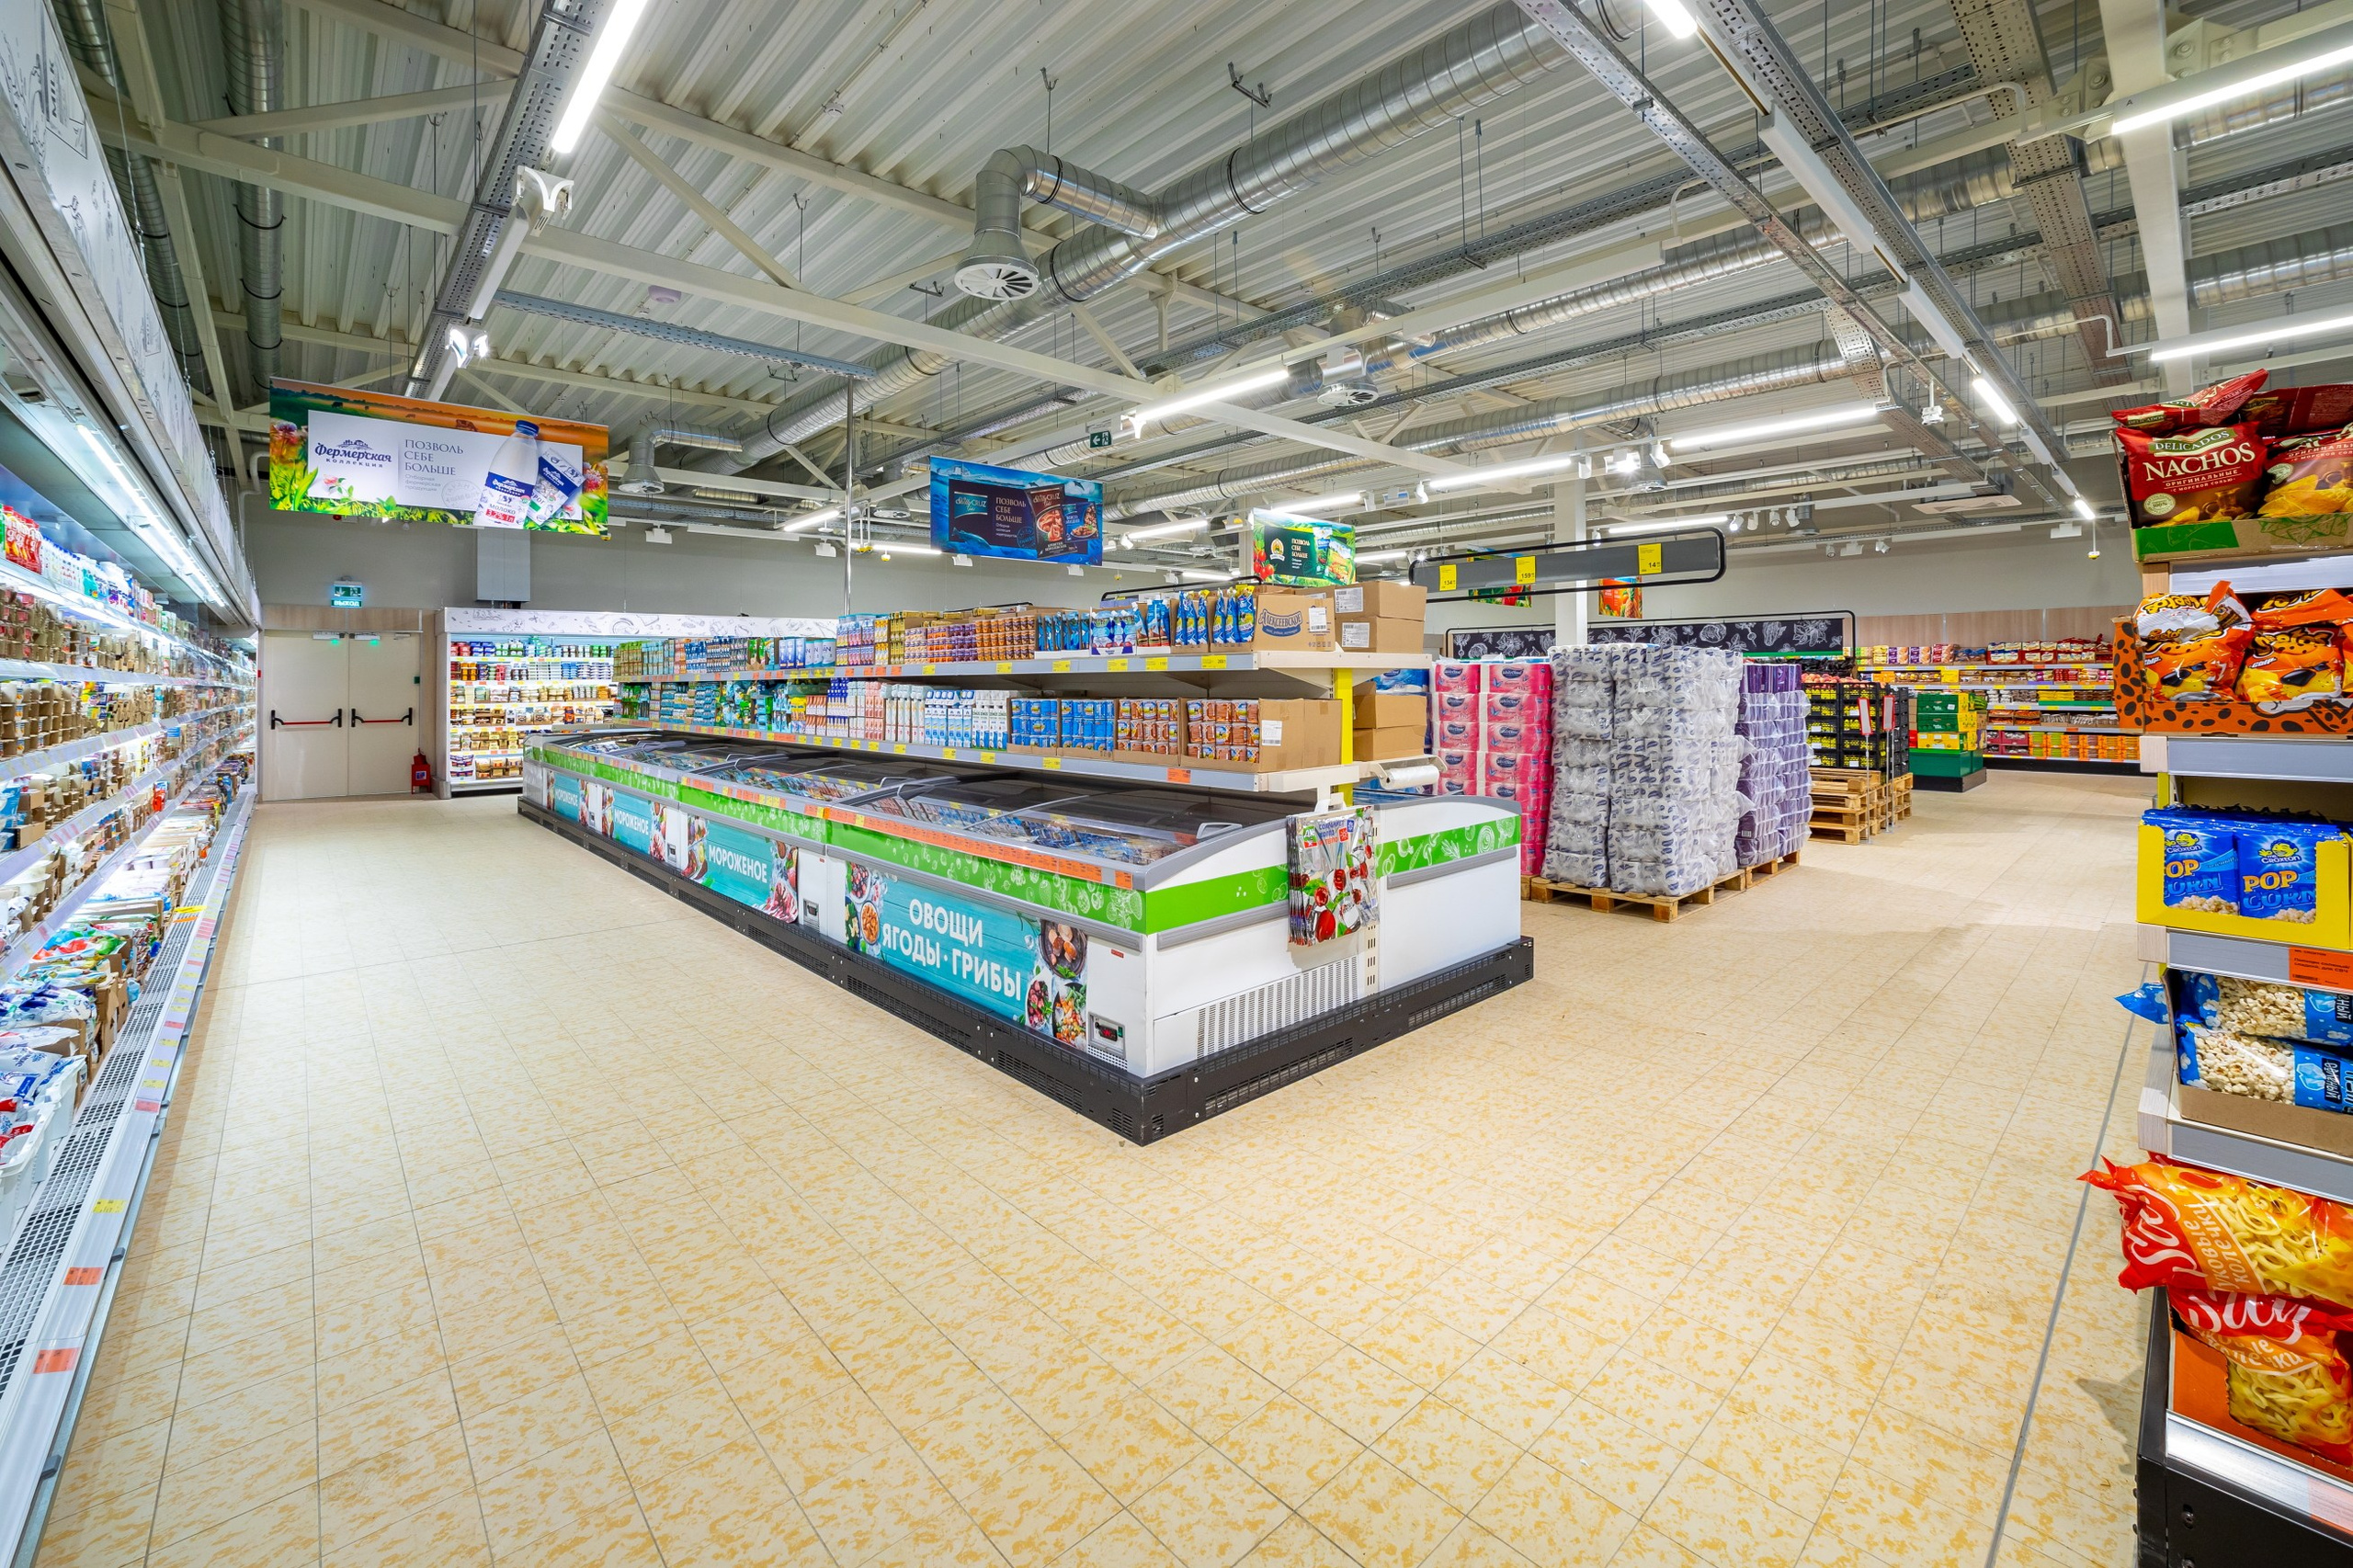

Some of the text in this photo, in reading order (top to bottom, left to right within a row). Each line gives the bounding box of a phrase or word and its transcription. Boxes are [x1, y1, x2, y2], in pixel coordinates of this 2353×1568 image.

[405, 439, 464, 454] ПОЗВОЛЬ
[2155, 430, 2230, 450] DELICADOS
[314, 442, 392, 462] Фермерская
[404, 450, 434, 462] СЕБЕ
[2288, 443, 2353, 458] ОРИГИНАЛЬ
[326, 458, 383, 468] коллекция
[405, 462, 456, 475] БОЛЬШЕ
[2143, 442, 2256, 482] NACHOS
[2165, 469, 2238, 487] ОРИГИНАЛЬНЫЕ
[2178, 483, 2209, 492] МОРСКОЙ
[995, 497, 1027, 507] ПОЗВОЛЬ
[995, 506, 1011, 514] СЕБЕ
[995, 515, 1023, 524] БОЛЬШЕ
[555, 789, 578, 807] МОРОЖЕНОЕ
[614, 808, 649, 836] МОРОЖЕНОЕ
[708, 844, 767, 884] МОРОЖЕНОЕ
[2165, 859, 2200, 878] OP
[2165, 878, 2221, 896] ORN
[2243, 870, 2298, 892] POP
[2243, 891, 2315, 909] CORN
[909, 898, 983, 948] ОВОЩИ
[882, 923, 1021, 1001] ЯГОДЫ ГРИБЫ
[2193, 1205, 2251, 1284] колечки
